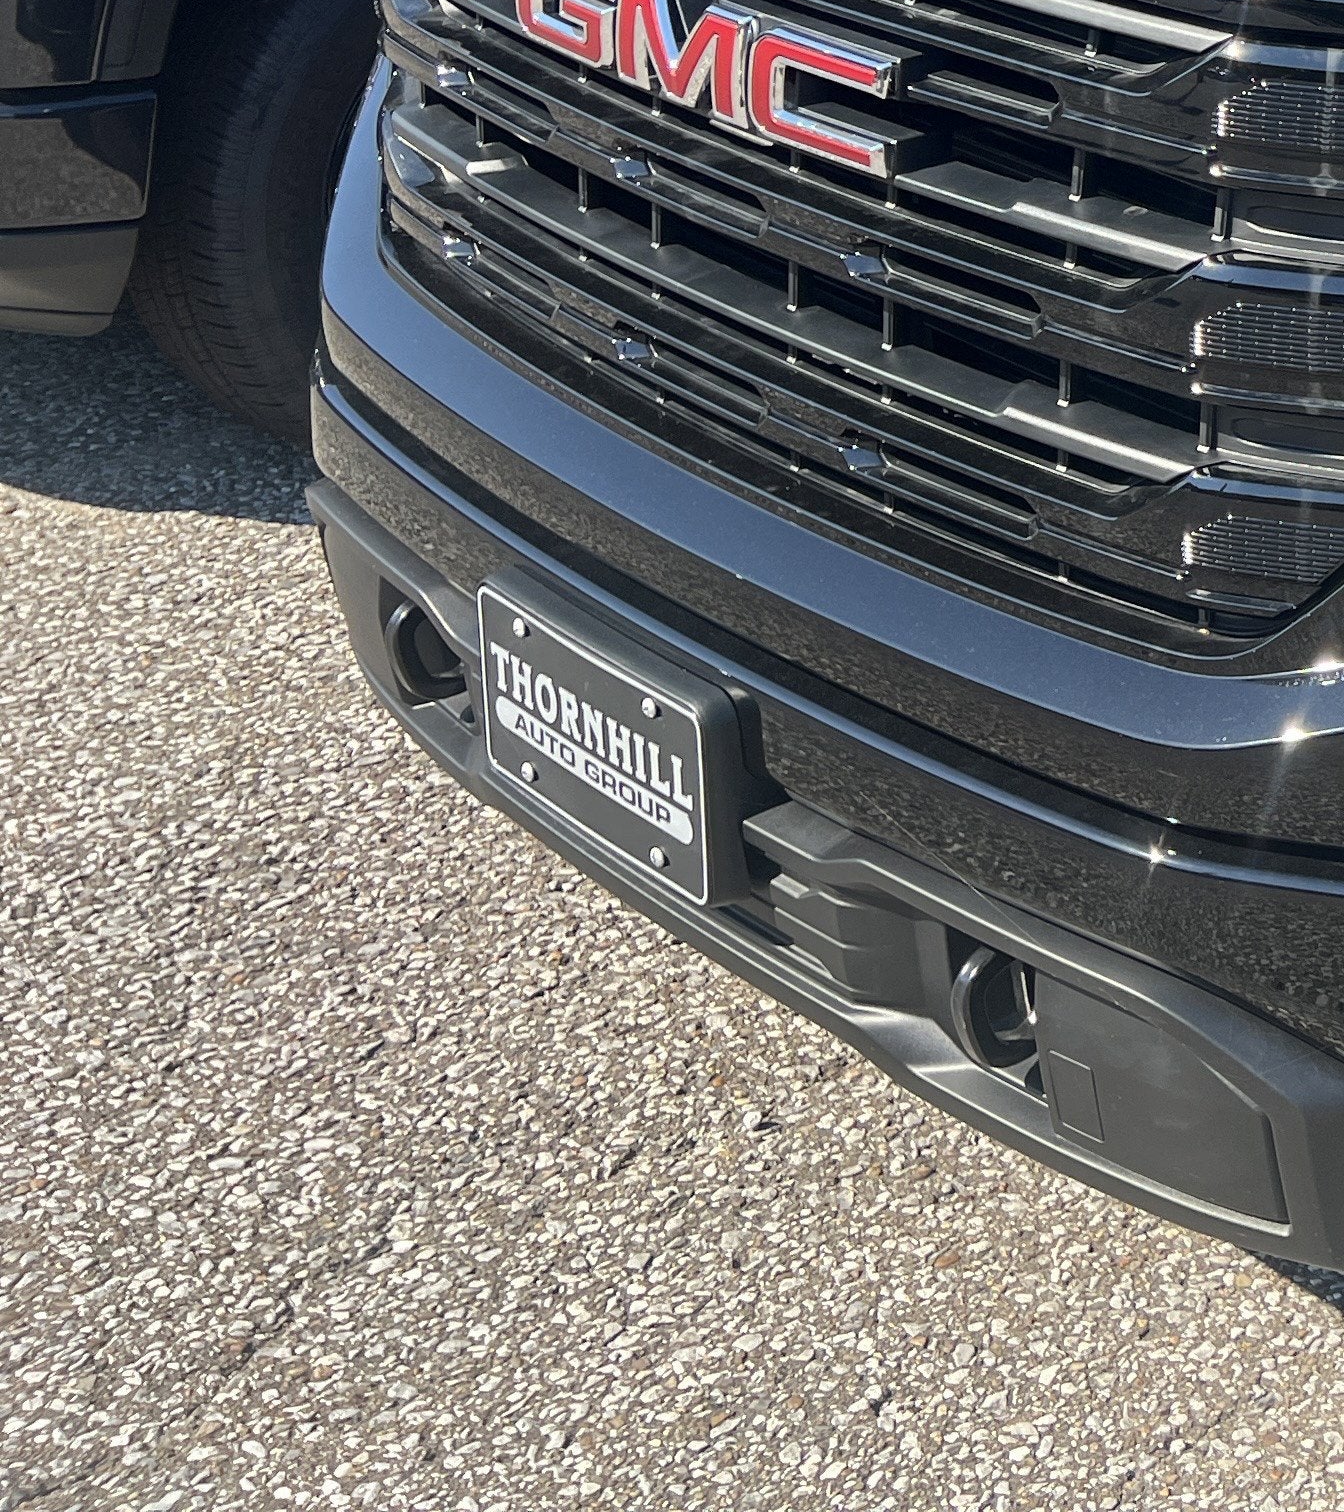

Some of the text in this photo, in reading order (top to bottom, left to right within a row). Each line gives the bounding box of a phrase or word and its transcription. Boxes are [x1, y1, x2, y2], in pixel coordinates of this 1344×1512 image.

[490, 642, 693, 812] THORNHILL
[514, 713, 672, 824] AUTO GROUP
